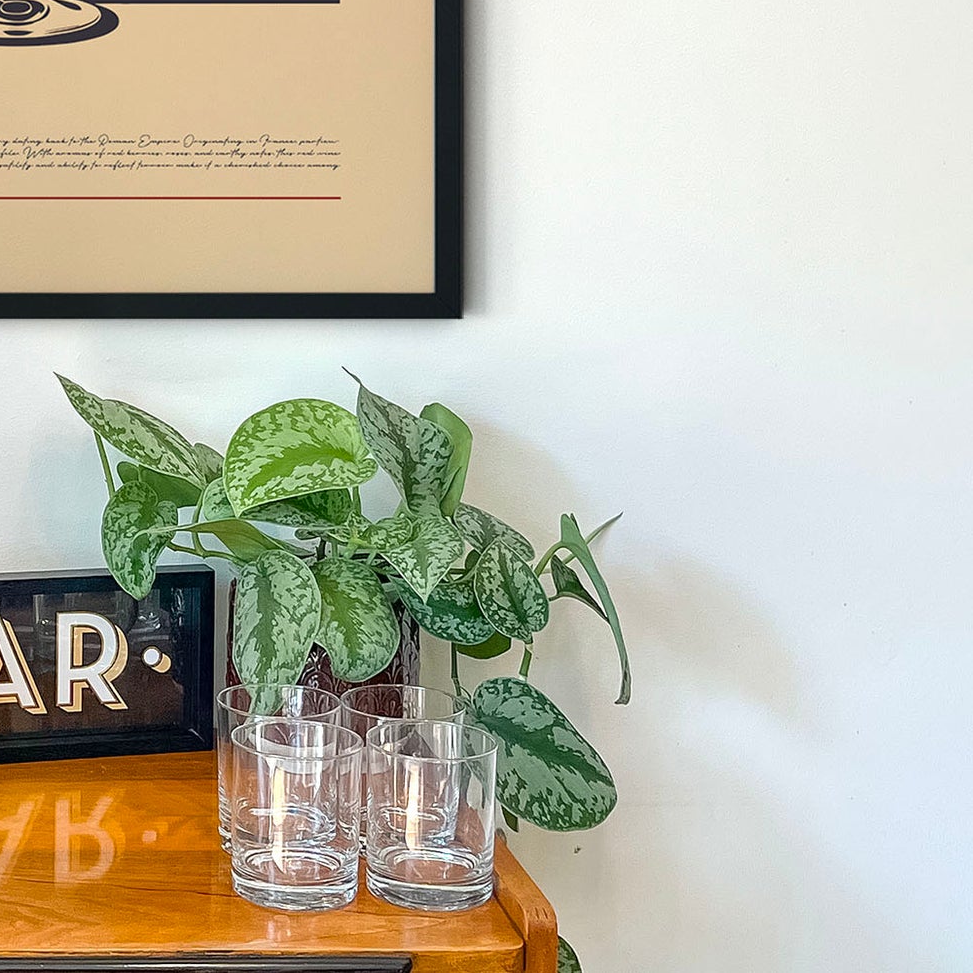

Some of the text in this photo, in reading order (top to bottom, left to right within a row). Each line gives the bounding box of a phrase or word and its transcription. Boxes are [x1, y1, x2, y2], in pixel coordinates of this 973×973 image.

[11, 136, 44, 148] dating
[22, 143, 55, 160] With
[214, 147, 249, 159] earthy
